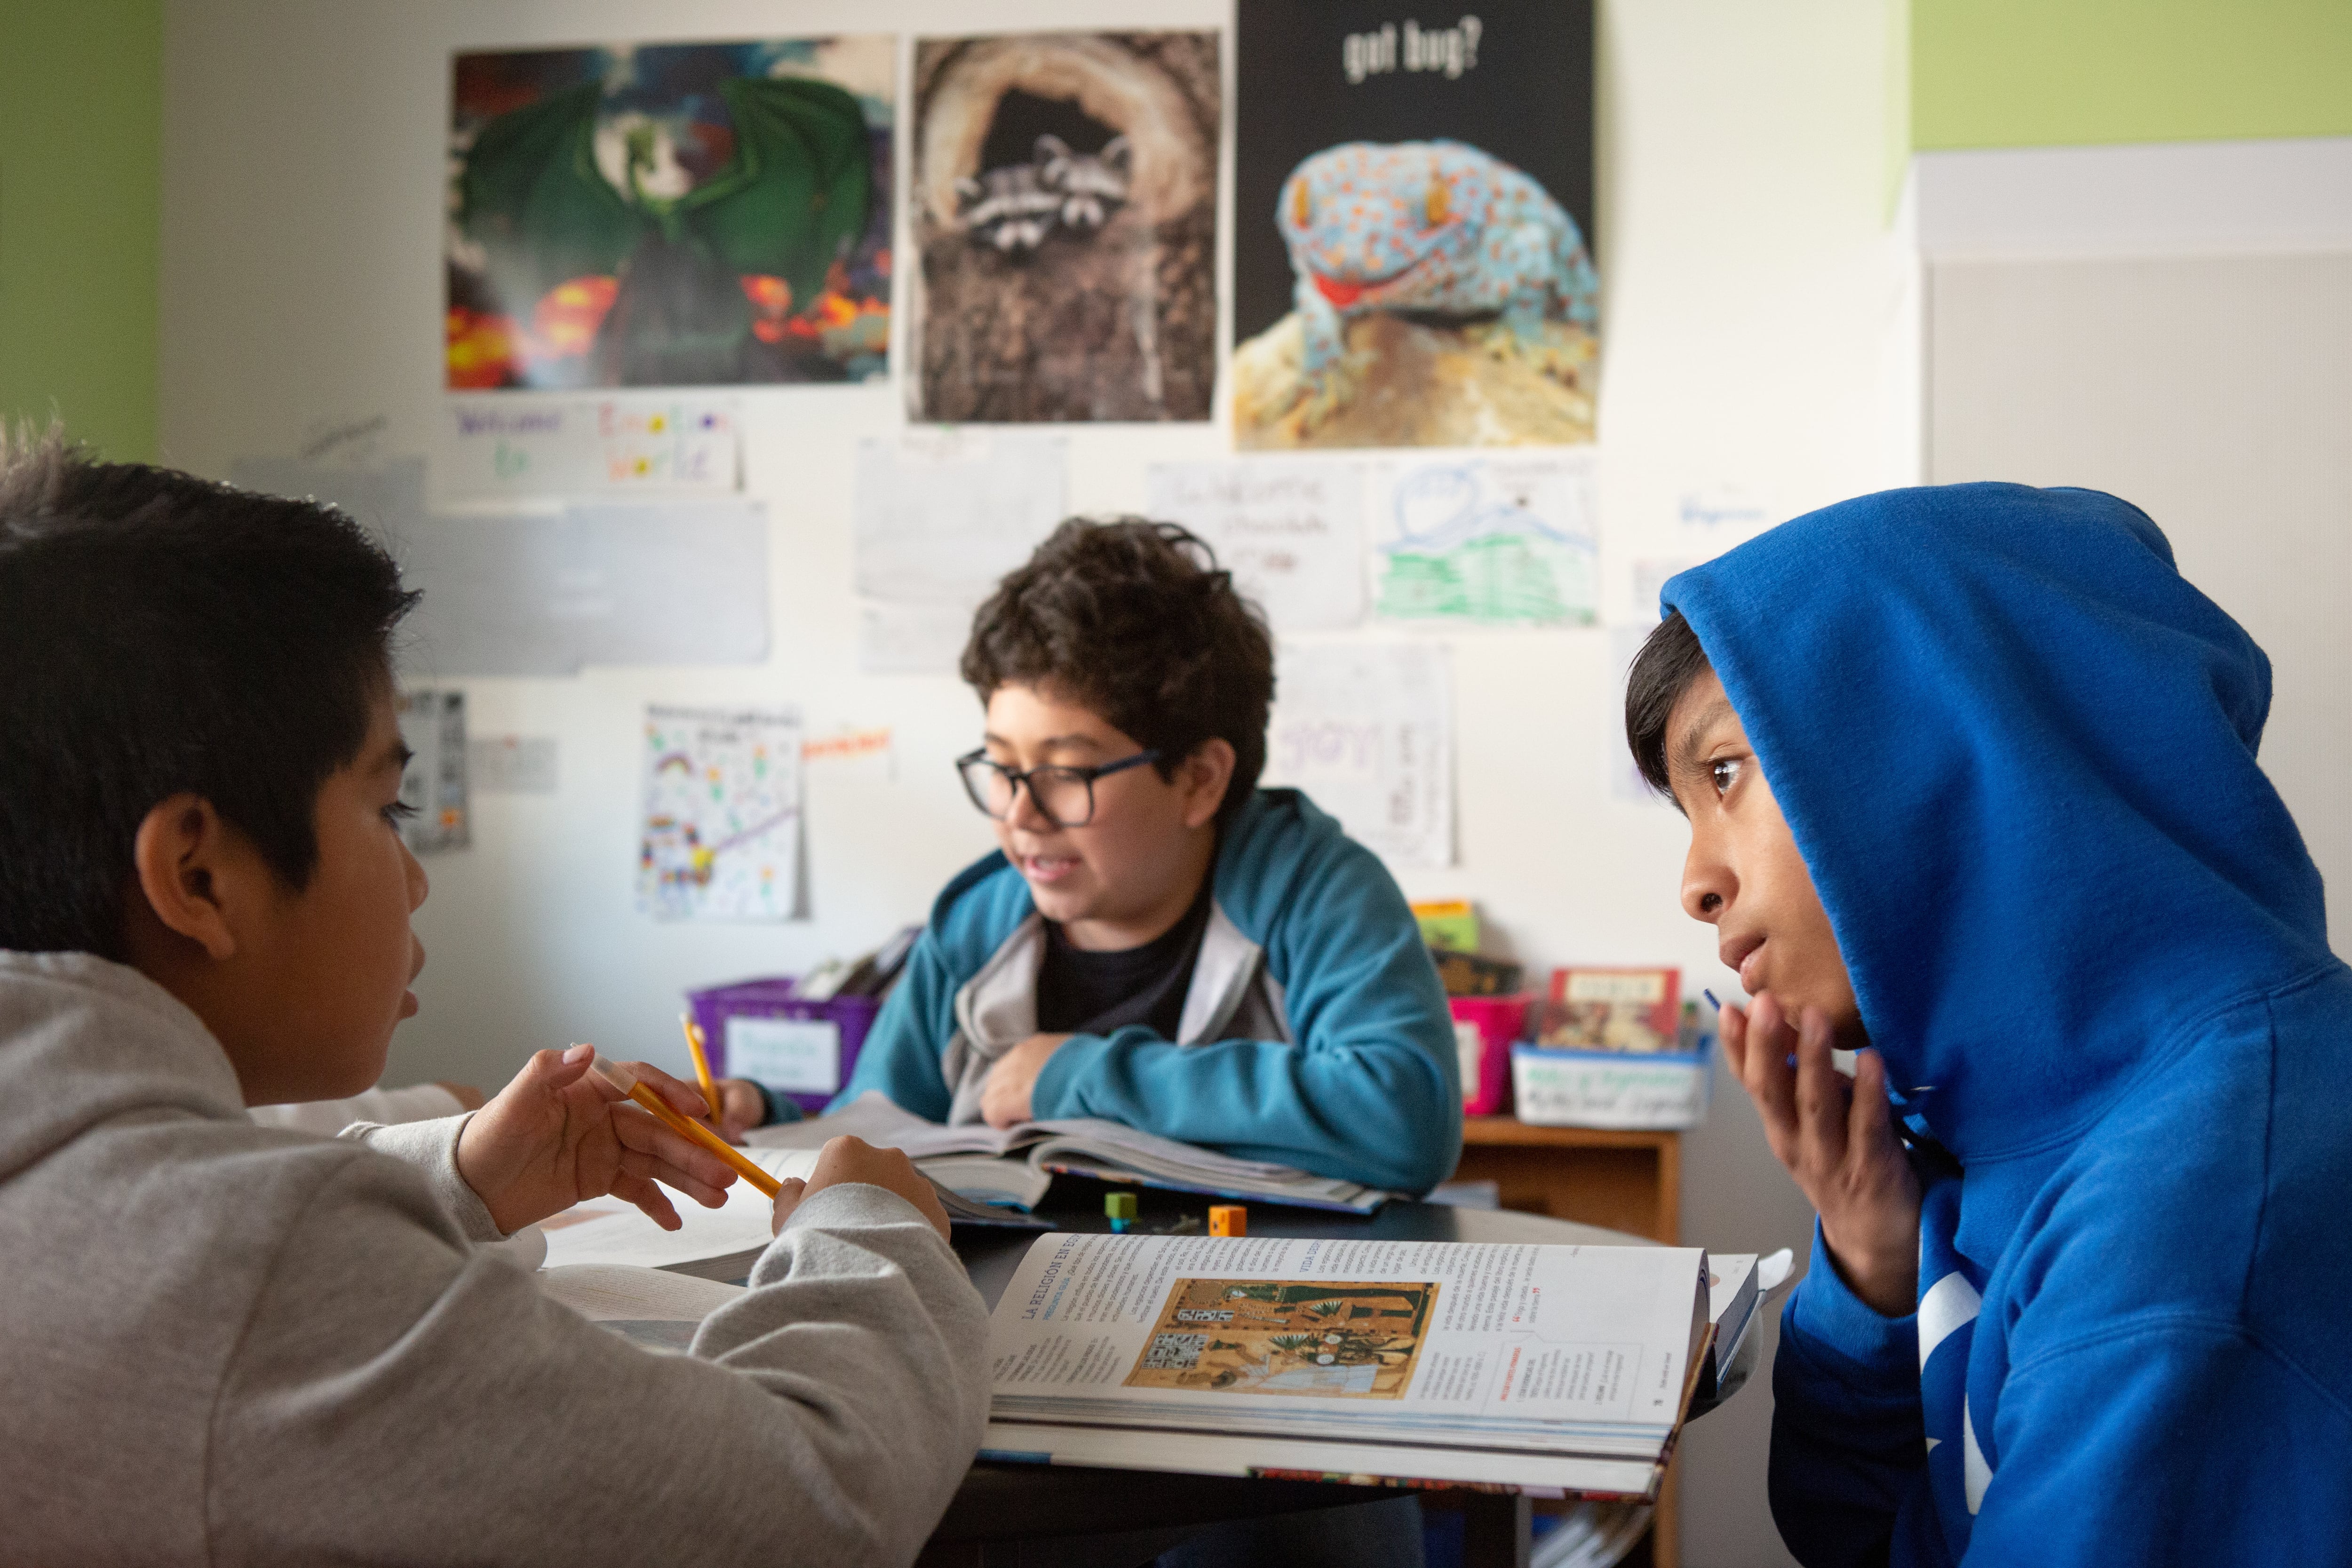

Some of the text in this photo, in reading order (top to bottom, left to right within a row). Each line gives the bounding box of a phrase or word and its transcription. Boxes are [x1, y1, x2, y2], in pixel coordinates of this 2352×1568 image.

[1343, 14, 1484, 85] got bug?
[1299, 1256, 1314, 1272] VIDA
[1030, 1262, 1061, 1305] RELIGIÓN
[1054, 1249, 1070, 1259] EN
[1503, 1278, 1514, 1299] después
[1447, 1293, 1459, 1314] después
[1461, 1294, 1471, 1311] mundo
[1444, 1315, 1453, 1326] vida
